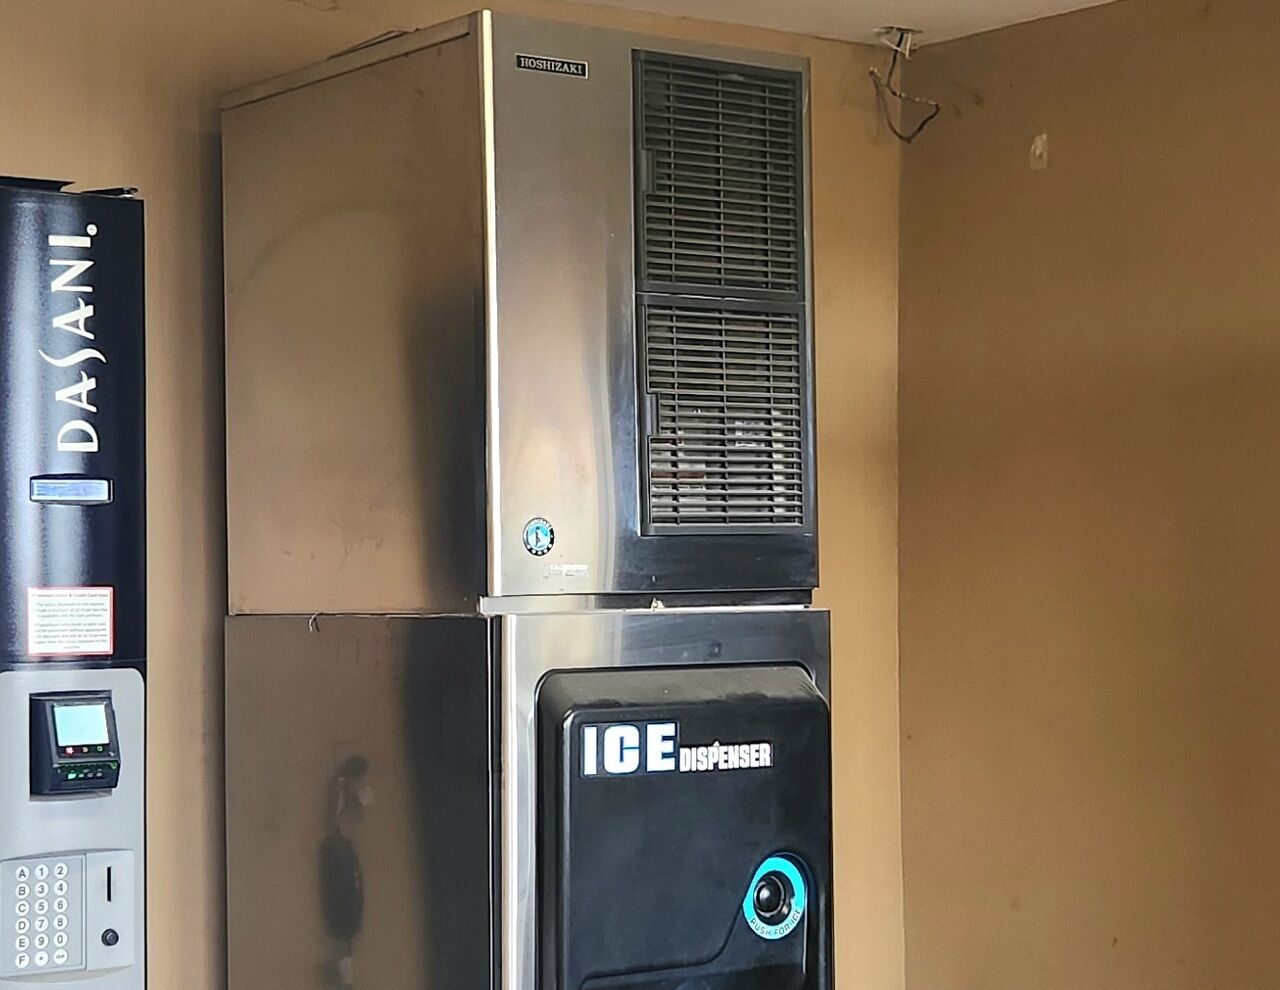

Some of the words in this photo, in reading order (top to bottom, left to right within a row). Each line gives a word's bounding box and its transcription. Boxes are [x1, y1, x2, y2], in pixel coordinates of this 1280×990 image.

[520, 57, 583, 76] HOSHIZAKI
[583, 723, 676, 776] ICE
[679, 741, 772, 773] DISPENSER
[18, 868, 26, 879] A
[39, 867, 44, 877] 1
[57, 866, 64, 875] 2
[18, 886, 26, 896] B
[38, 885, 45, 894] 3
[57, 883, 64, 892] 4
[18, 903, 26, 913] C
[38, 902, 45, 911] 5
[57, 900, 64, 909] 6
[18, 921, 26, 930] D
[38, 919, 45, 929] 7
[57, 917, 64, 927] 8
[750, 917, 772, 936] PUSH
[773, 925, 791, 935] FOR
[789, 908, 802, 928] ICE
[18, 938, 26, 948] E
[38, 936, 45, 946] 9
[57, 934, 64, 944] 0
[18, 955, 26, 965] F
